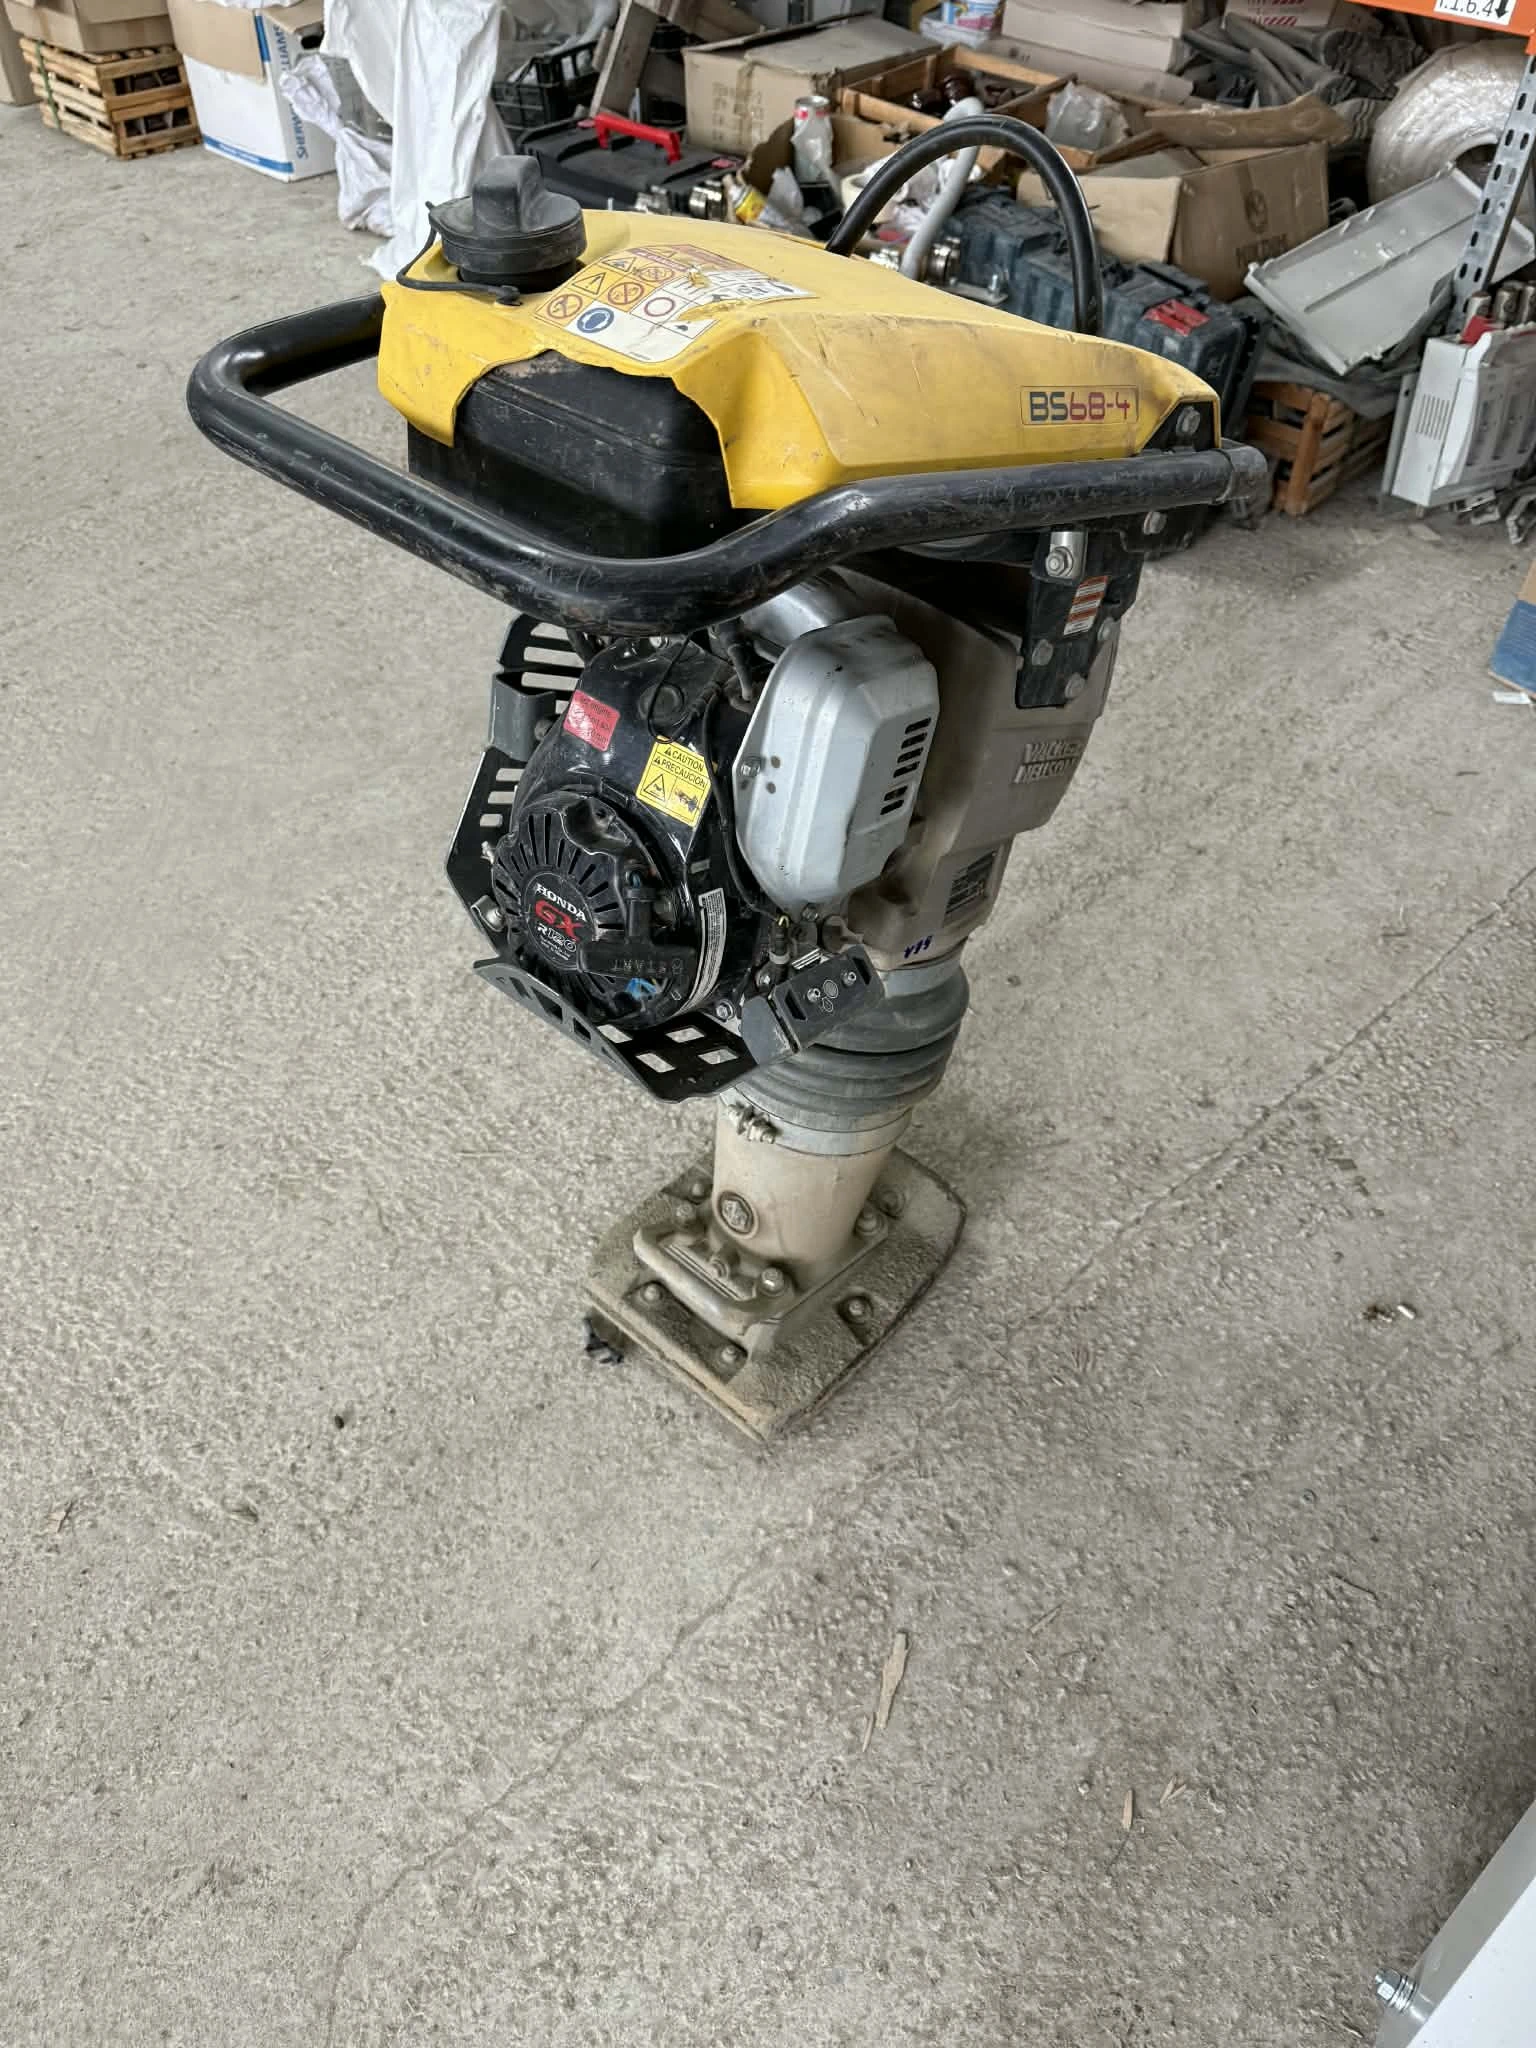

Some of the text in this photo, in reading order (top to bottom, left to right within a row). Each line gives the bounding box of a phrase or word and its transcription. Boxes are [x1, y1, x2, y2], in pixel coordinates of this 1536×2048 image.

[1029, 391, 1131, 422] BS68-4
[672, 750, 704, 773] CAUTION
[535, 882, 587, 923] HONDA
[535, 899, 585, 943] GX
